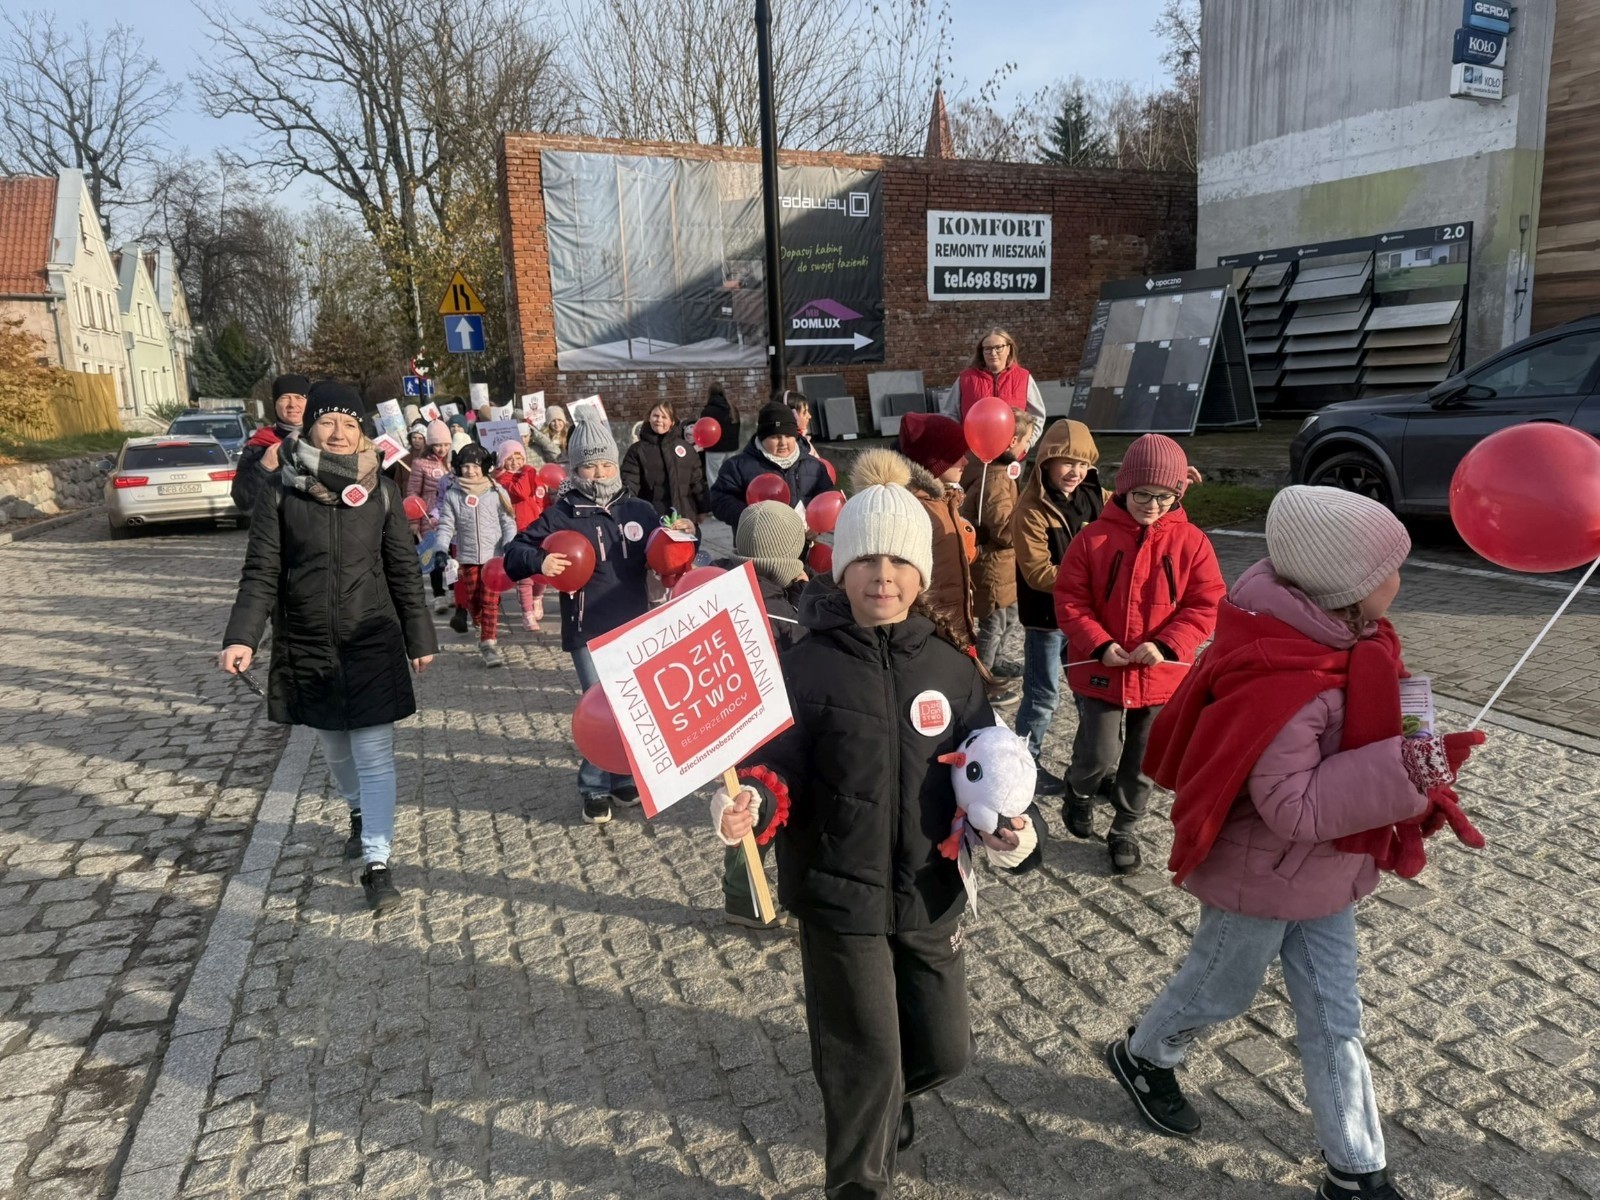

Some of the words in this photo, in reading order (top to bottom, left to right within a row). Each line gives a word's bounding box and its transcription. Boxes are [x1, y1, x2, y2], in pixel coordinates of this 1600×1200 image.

[1475, 2, 1509, 18] GERDA
[1469, 36, 1497, 53] KOŁO
[938, 217, 1045, 237] KOMFORT
[1443, 226, 1465, 239] 2.0
[935, 243, 988, 258] REMONTY
[992, 240, 1046, 258] MIESZKAŃ
[797, 261, 807, 272] do
[811, 259, 835, 273] swojej
[993, 271, 1013, 290] 851
[1016, 273, 1037, 289] 179
[1156, 278, 1181, 287] opoczno
[805, 309, 819, 317] MB
[792, 319, 840, 329] DOMLUX
[626, 613, 701, 665] UDZIAŁ
[699, 594, 719, 616] W
[730, 603, 774, 697] KAMPANII
[672, 672, 742, 732] STWO
[615, 677, 673, 775] BIERZEMY
[679, 704, 766, 776] dziecinstwobezprzemocy.pl
[681, 731, 699, 748] BEZ
